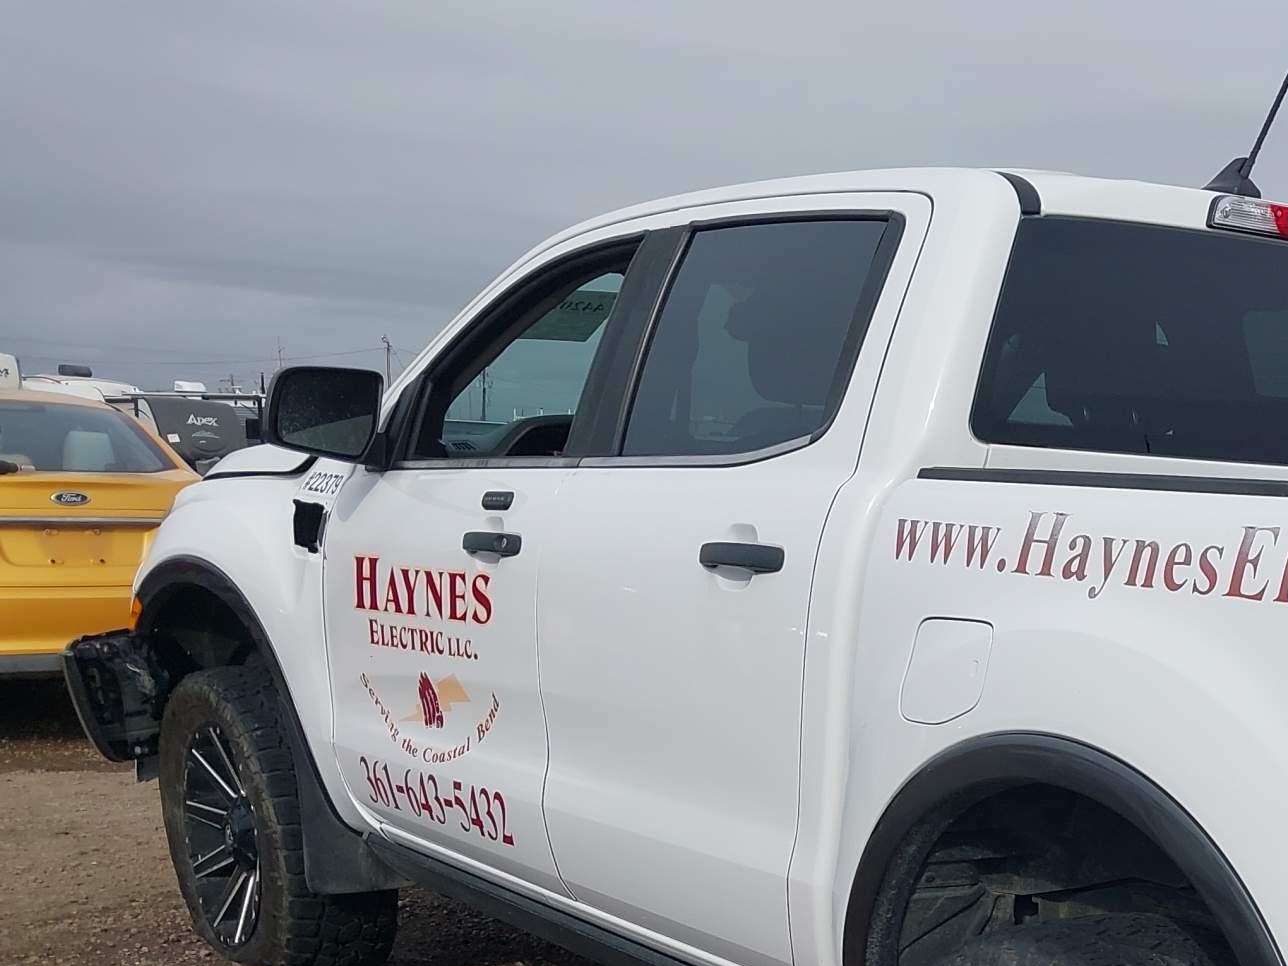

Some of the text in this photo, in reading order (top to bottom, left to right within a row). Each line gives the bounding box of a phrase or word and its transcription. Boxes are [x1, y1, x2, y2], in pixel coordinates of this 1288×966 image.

[186, 413, 219, 427] Apex
[303, 469, 345, 496] #22379
[354, 555, 493, 625] HAYNES
[369, 619, 444, 656] ELECTRIC
[360, 672, 500, 764] Serving the Coastal Bend
[359, 755, 515, 846] 361-643-5432
